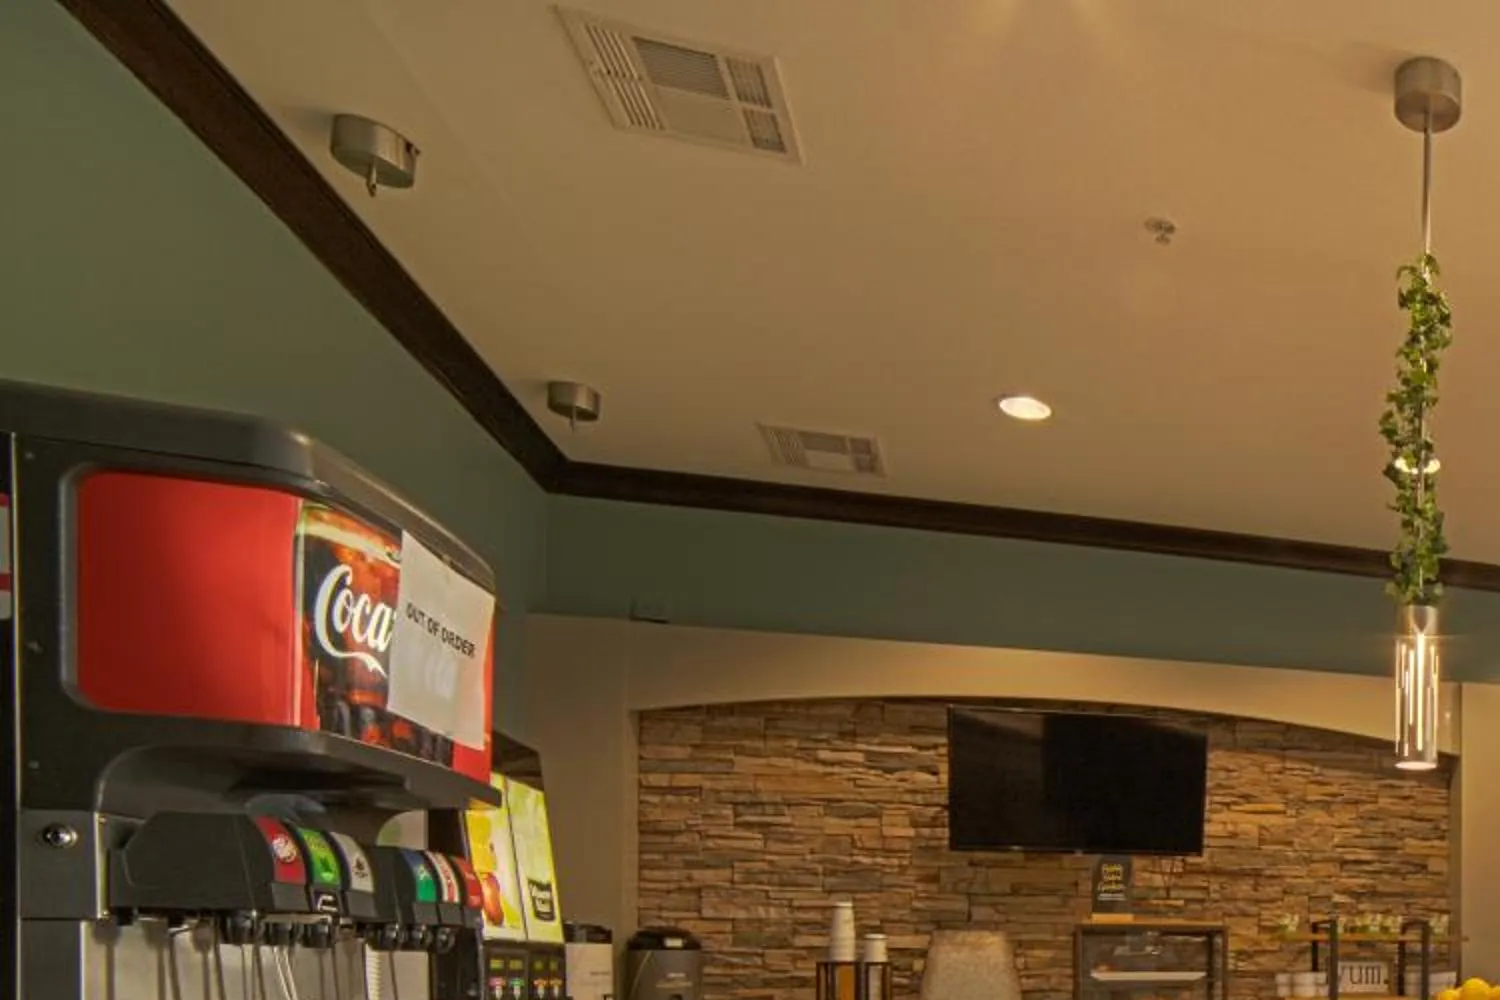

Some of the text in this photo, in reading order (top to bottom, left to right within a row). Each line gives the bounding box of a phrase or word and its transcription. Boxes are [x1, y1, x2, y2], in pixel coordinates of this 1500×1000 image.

[406, 602, 476, 658] OUT OF ORDER
